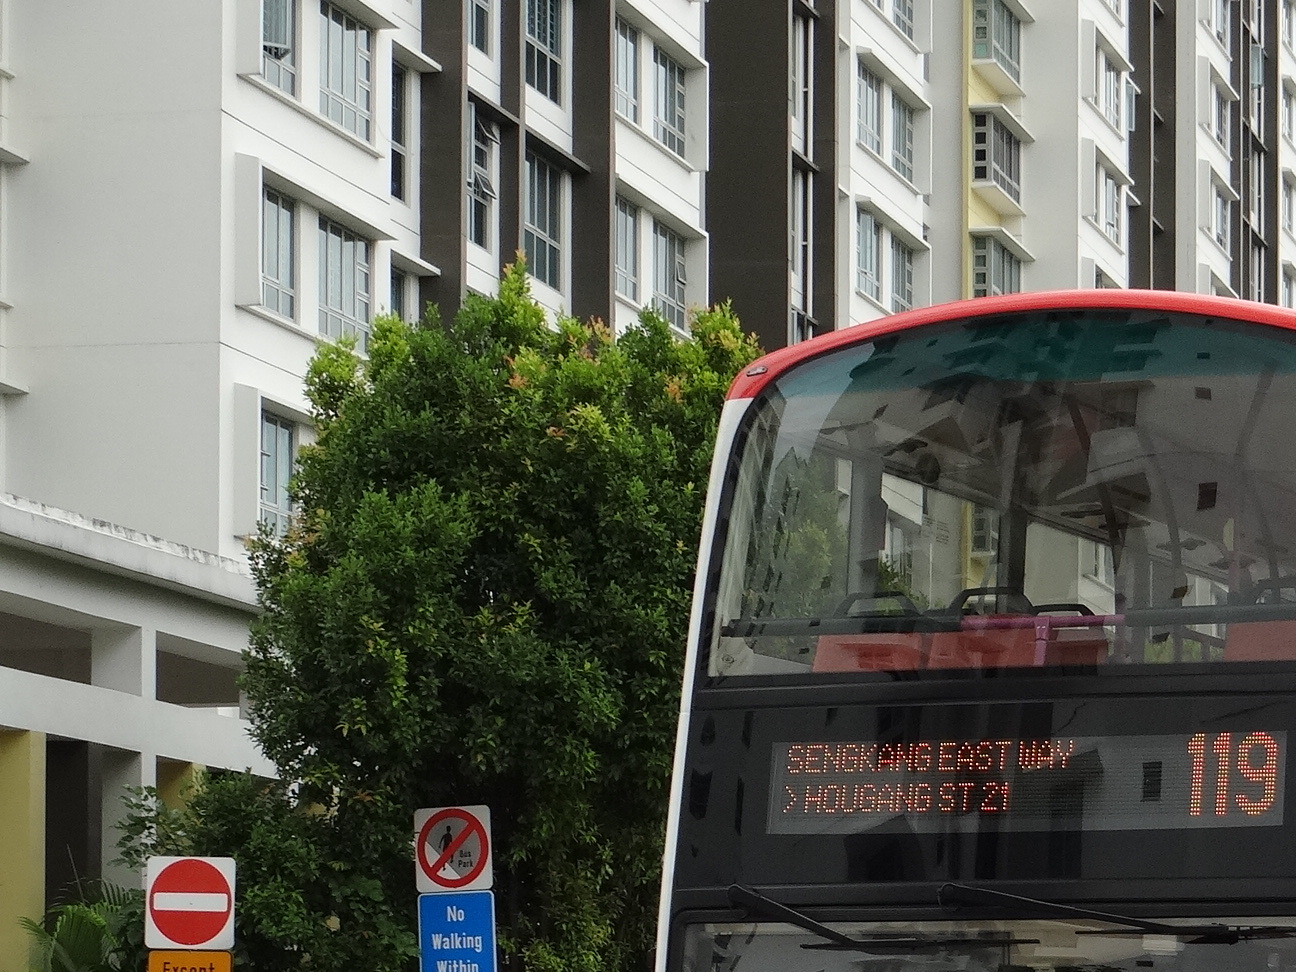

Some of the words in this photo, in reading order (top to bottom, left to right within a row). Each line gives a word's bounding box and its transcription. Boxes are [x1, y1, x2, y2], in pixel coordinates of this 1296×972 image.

[786, 742, 932, 774] SENGKANG
[938, 740, 1012, 771] EAST
[1017, 739, 1074, 770] WAY
[1187, 731, 1280, 817] 119
[938, 781, 975, 812] ST
[980, 781, 1010, 811] 21
[457, 859, 474, 868] Park
[459, 849, 472, 859] Bus
[446, 906, 465, 922] No
[432, 932, 482, 953] Walking
